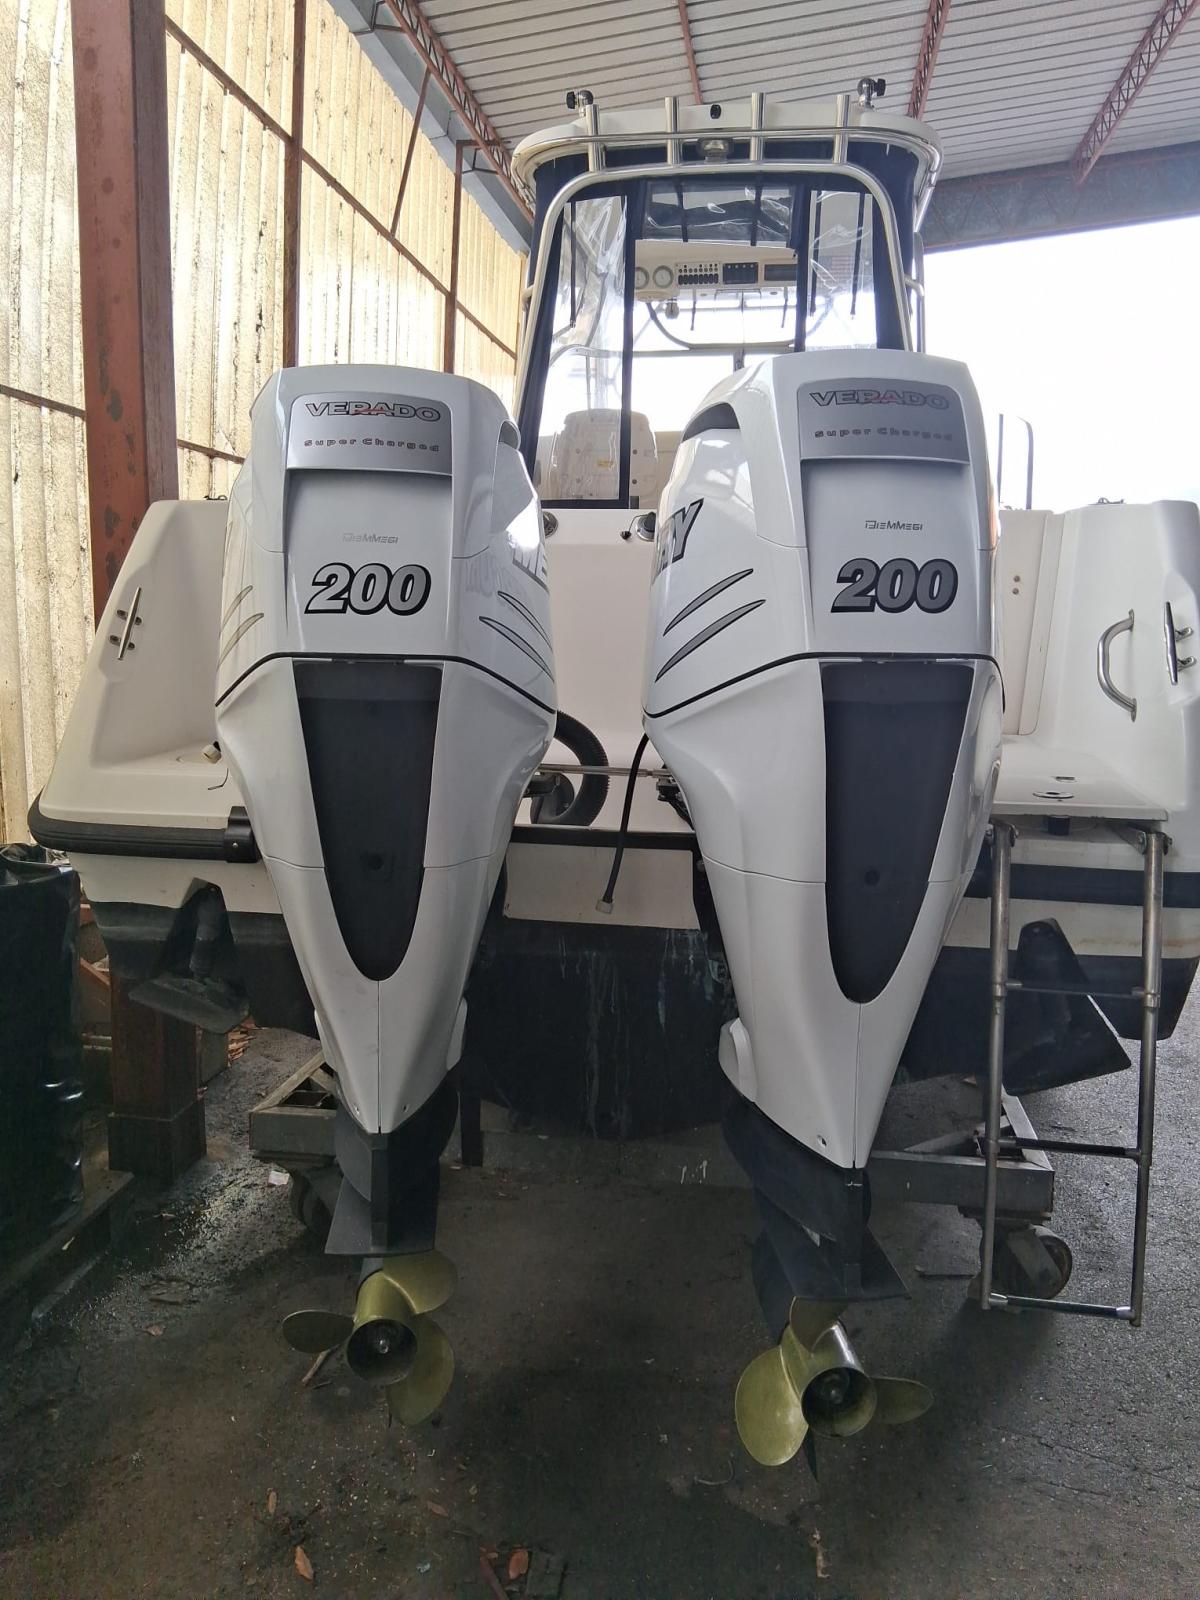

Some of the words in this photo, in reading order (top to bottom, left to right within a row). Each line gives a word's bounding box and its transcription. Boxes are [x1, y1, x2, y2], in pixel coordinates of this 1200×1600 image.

[305, 401, 442, 423] VERADO
[808, 389, 950, 410] VERADO
[303, 562, 432, 616] 200
[830, 557, 959, 614] 200
